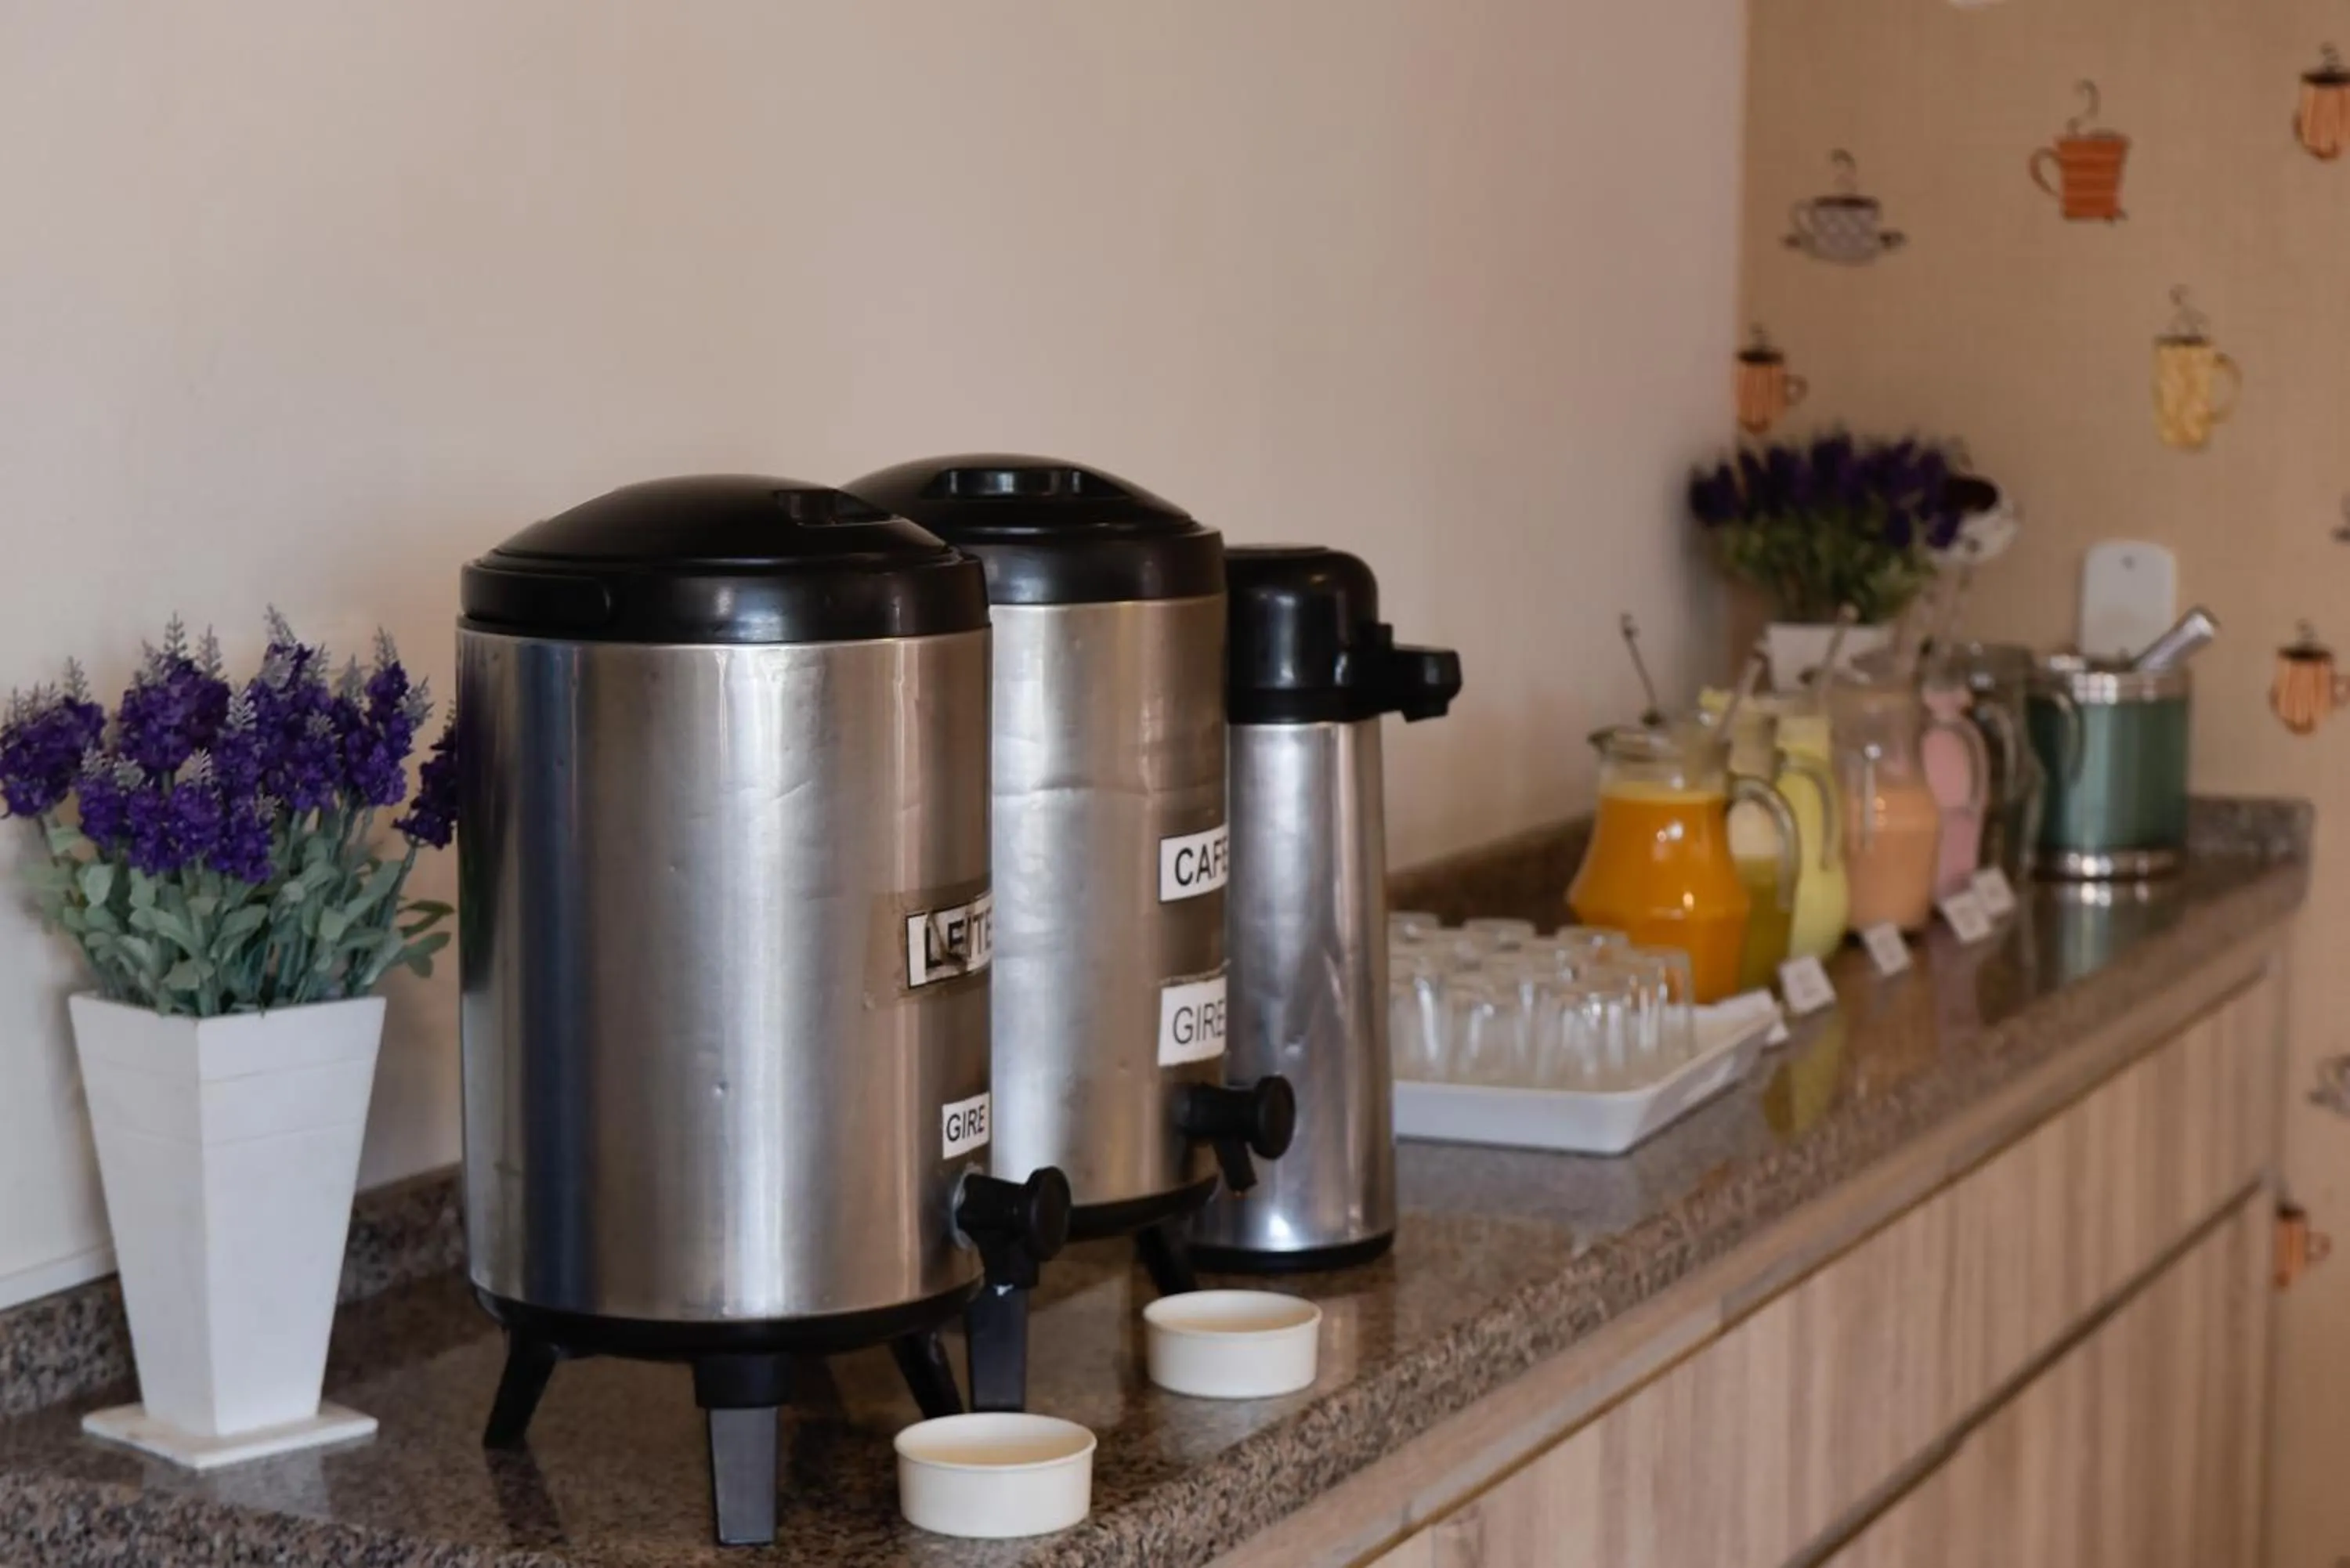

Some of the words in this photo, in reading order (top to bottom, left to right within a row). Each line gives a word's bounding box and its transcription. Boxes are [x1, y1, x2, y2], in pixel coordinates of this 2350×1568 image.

[925, 906, 992, 970] LEITE
[1173, 999, 1225, 1044] GIRE
[946, 1103, 985, 1142] GIRE
